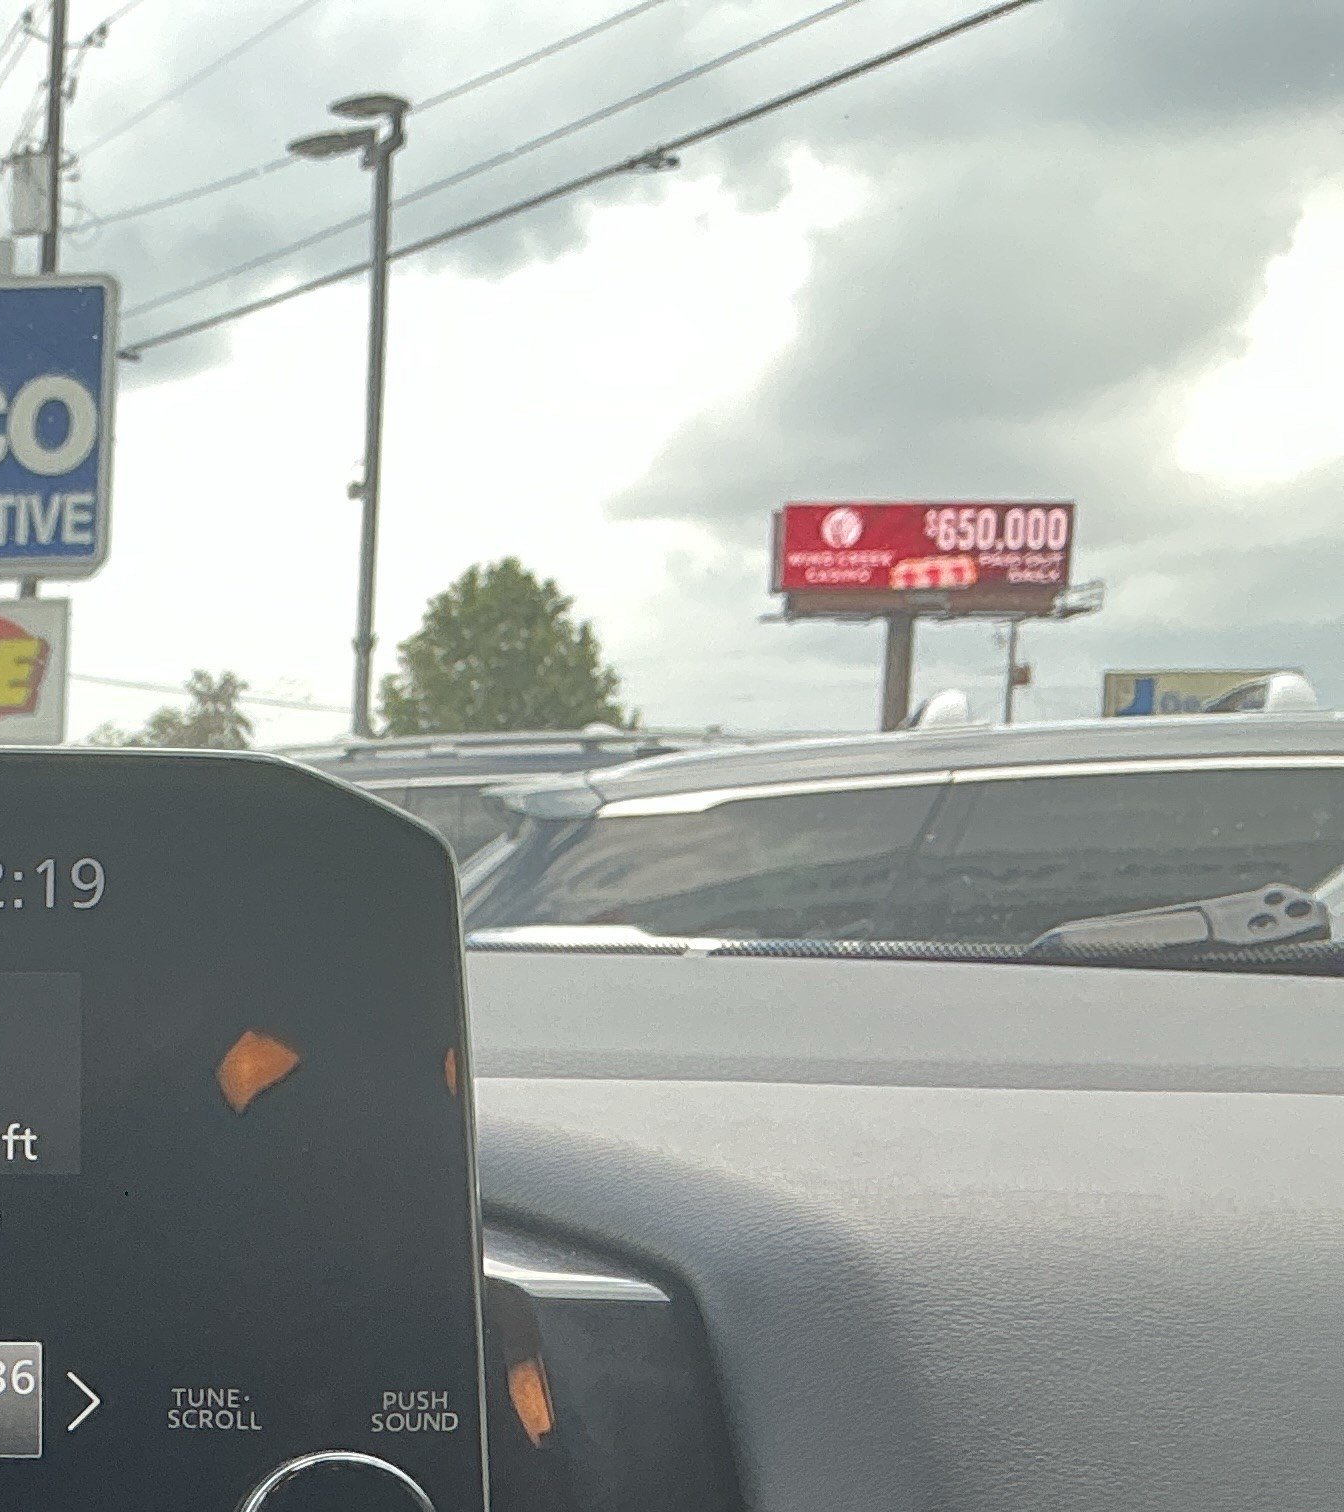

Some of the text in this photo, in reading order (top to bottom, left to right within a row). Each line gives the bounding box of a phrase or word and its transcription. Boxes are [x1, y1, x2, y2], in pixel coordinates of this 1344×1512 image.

[924, 507, 1068, 551] $650,000
[0, 1121, 40, 1162] ft
[382, 1390, 449, 1411] PUSH
[167, 1409, 263, 1431] SCROLL
[371, 1412, 460, 1433] SOUND
